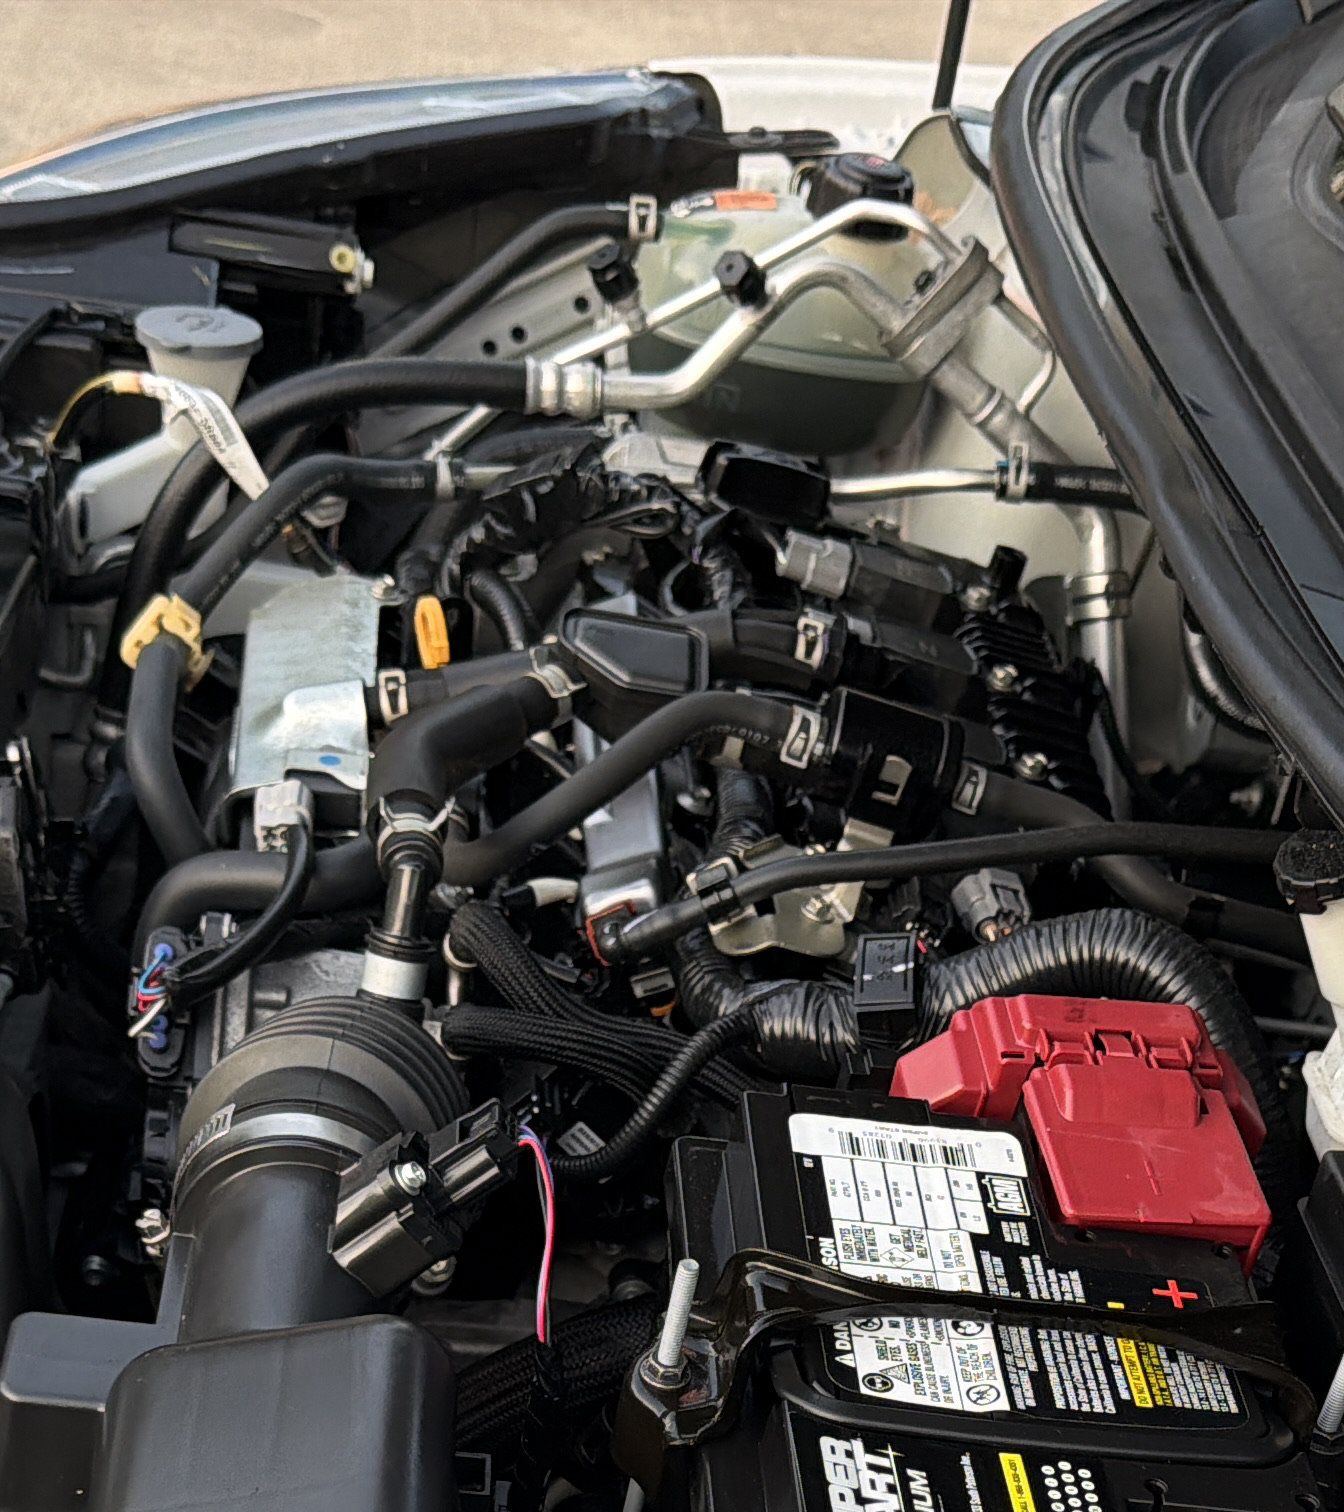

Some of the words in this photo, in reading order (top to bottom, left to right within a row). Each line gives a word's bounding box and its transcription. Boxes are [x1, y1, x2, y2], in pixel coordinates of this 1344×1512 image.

[990, 1178, 1025, 1212] AGM
[839, 1228, 851, 1241] EYES
[889, 1233, 901, 1244] GET
[900, 1228, 914, 1251] MEDICAL
[818, 1237, 839, 1269] SON
[841, 1242, 854, 1259] FLUSH
[831, 1321, 851, 1350] DAN
[875, 1339, 889, 1360] SHIELD
[905, 1342, 919, 1361] GASES
[960, 1368, 973, 1382] KEEP
[1122, 1354, 1142, 1381] ATTEMPT
[909, 1362, 926, 1395] EXPLOSIVE
[1130, 1381, 1146, 1394] NOT
[1134, 1394, 1149, 1404] DO
